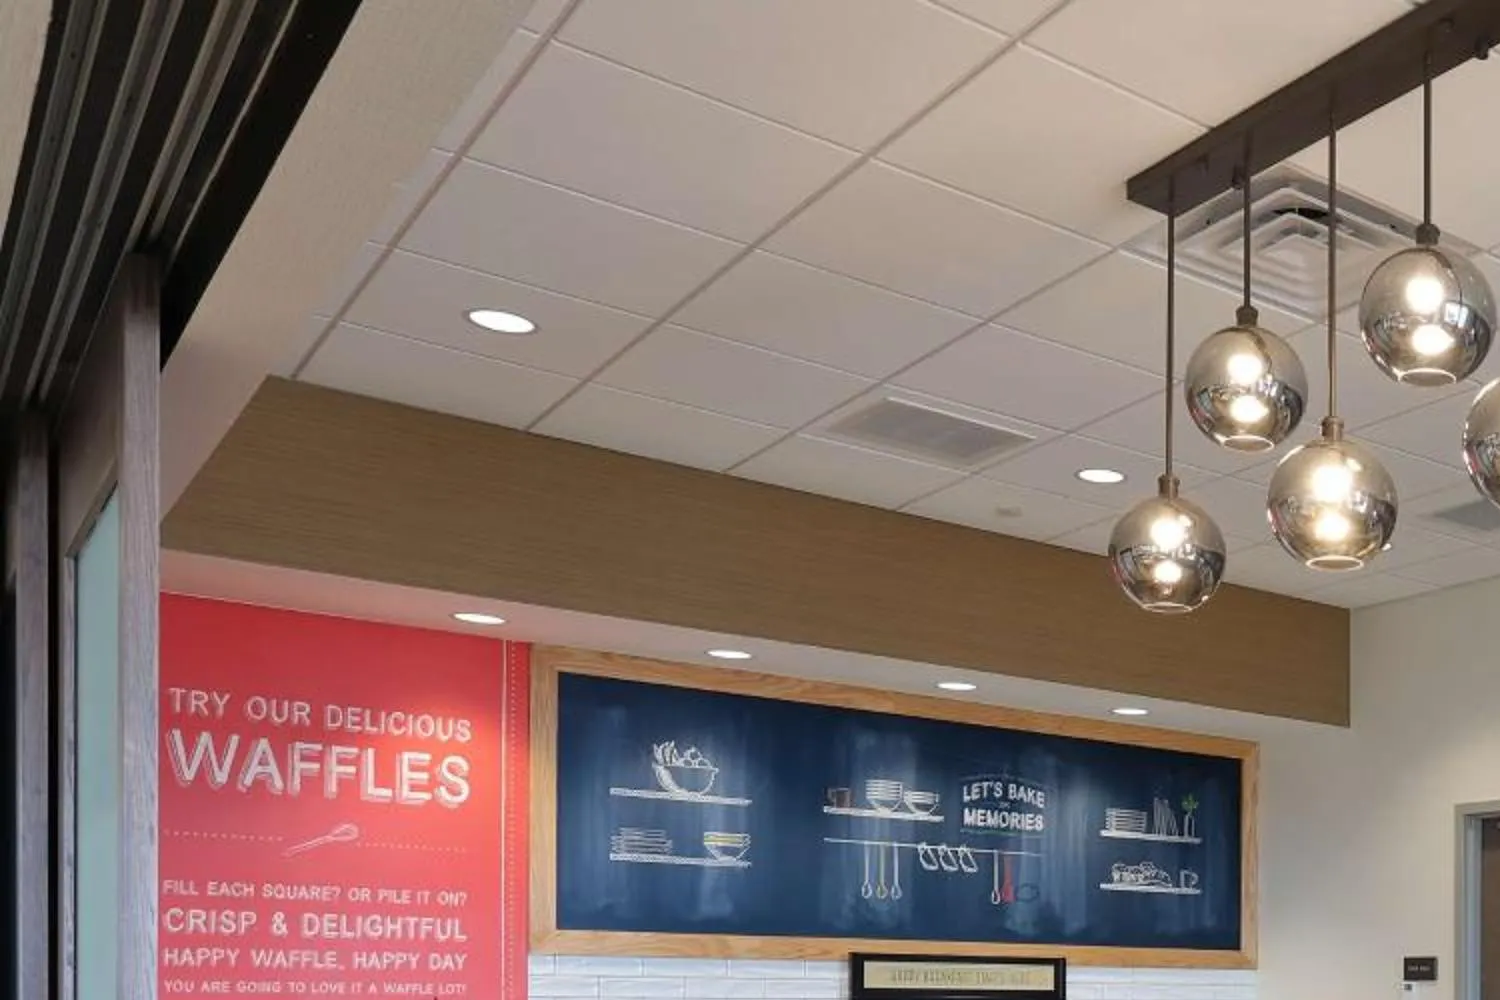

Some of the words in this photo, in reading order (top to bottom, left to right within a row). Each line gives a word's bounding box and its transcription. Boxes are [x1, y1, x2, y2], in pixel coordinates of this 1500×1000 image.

[169, 687, 231, 718] TRY
[246, 695, 311, 726] OUR
[325, 704, 473, 744] DELICIOUS
[165, 728, 471, 809] WAFFLES
[963, 781, 1003, 803] LET'S
[1008, 783, 1045, 809] BAKE
[963, 807, 1045, 832] MEMORIES
[163, 880, 198, 896] FILL
[207, 881, 255, 897] EACH
[262, 884, 341, 901] SQUARE?
[348, 888, 371, 901] OR
[378, 889, 412, 904] PILE
[417, 890, 430, 905] IT
[437, 891, 467, 907] ON?
[163, 908, 257, 935] CRISP
[271, 911, 289, 936] &
[303, 912, 468, 942] DELIGHTFUL
[163, 948, 240, 967] HAPPY
[353, 952, 420, 969] HAPPY
[429, 953, 467, 970] DAY
[163, 980, 195, 993] YOU
[202, 981, 231, 993] ARE
[236, 981, 281, 994] GOING
[287, 982, 306, 993] TO
[311, 982, 346, 994] LOVE
[352, 982, 363, 994] IT
[367, 983, 378, 994] A
[383, 982, 433, 995] WAFFLE
